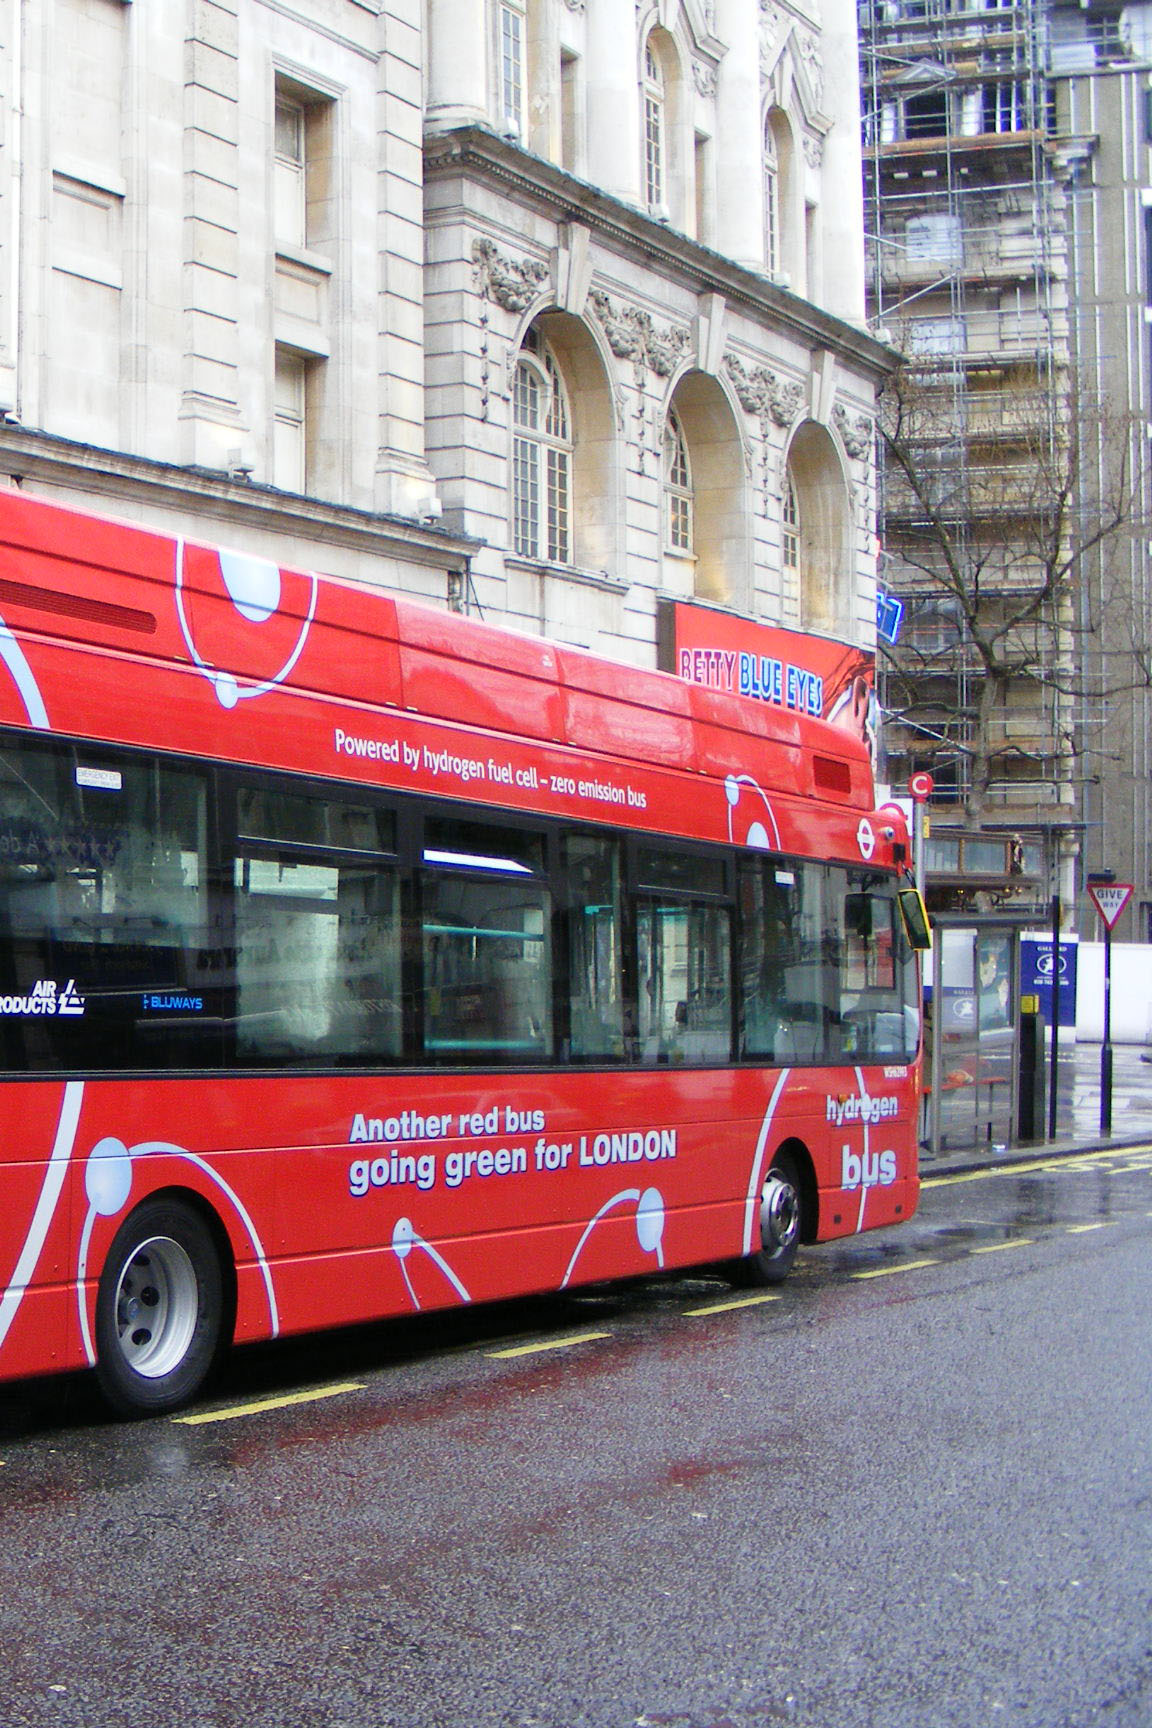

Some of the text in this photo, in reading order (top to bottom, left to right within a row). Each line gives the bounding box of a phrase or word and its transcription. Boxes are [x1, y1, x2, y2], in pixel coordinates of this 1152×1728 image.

[680, 648, 823, 717] BETTY BLUE EYES
[335, 729, 400, 762] Powered
[403, 741, 420, 771] by
[424, 746, 485, 781] hydrogen
[487, 758, 513, 785] fuel
[515, 768, 538, 789] cell
[550, 774, 576, 796] zero
[578, 779, 626, 804] emission
[627, 785, 647, 809] bus
[912, 775, 928, 794] C
[1097, 889, 1123, 900] GIVE
[32, 980, 57, 997] AIR
[151, 996, 203, 1009] BLUWAYS
[349, 1105, 545, 1143] Another red bus
[826, 1093, 898, 1126] hydrogen
[349, 1130, 677, 1196] going green for LONDON
[841, 1145, 897, 1190] bus
